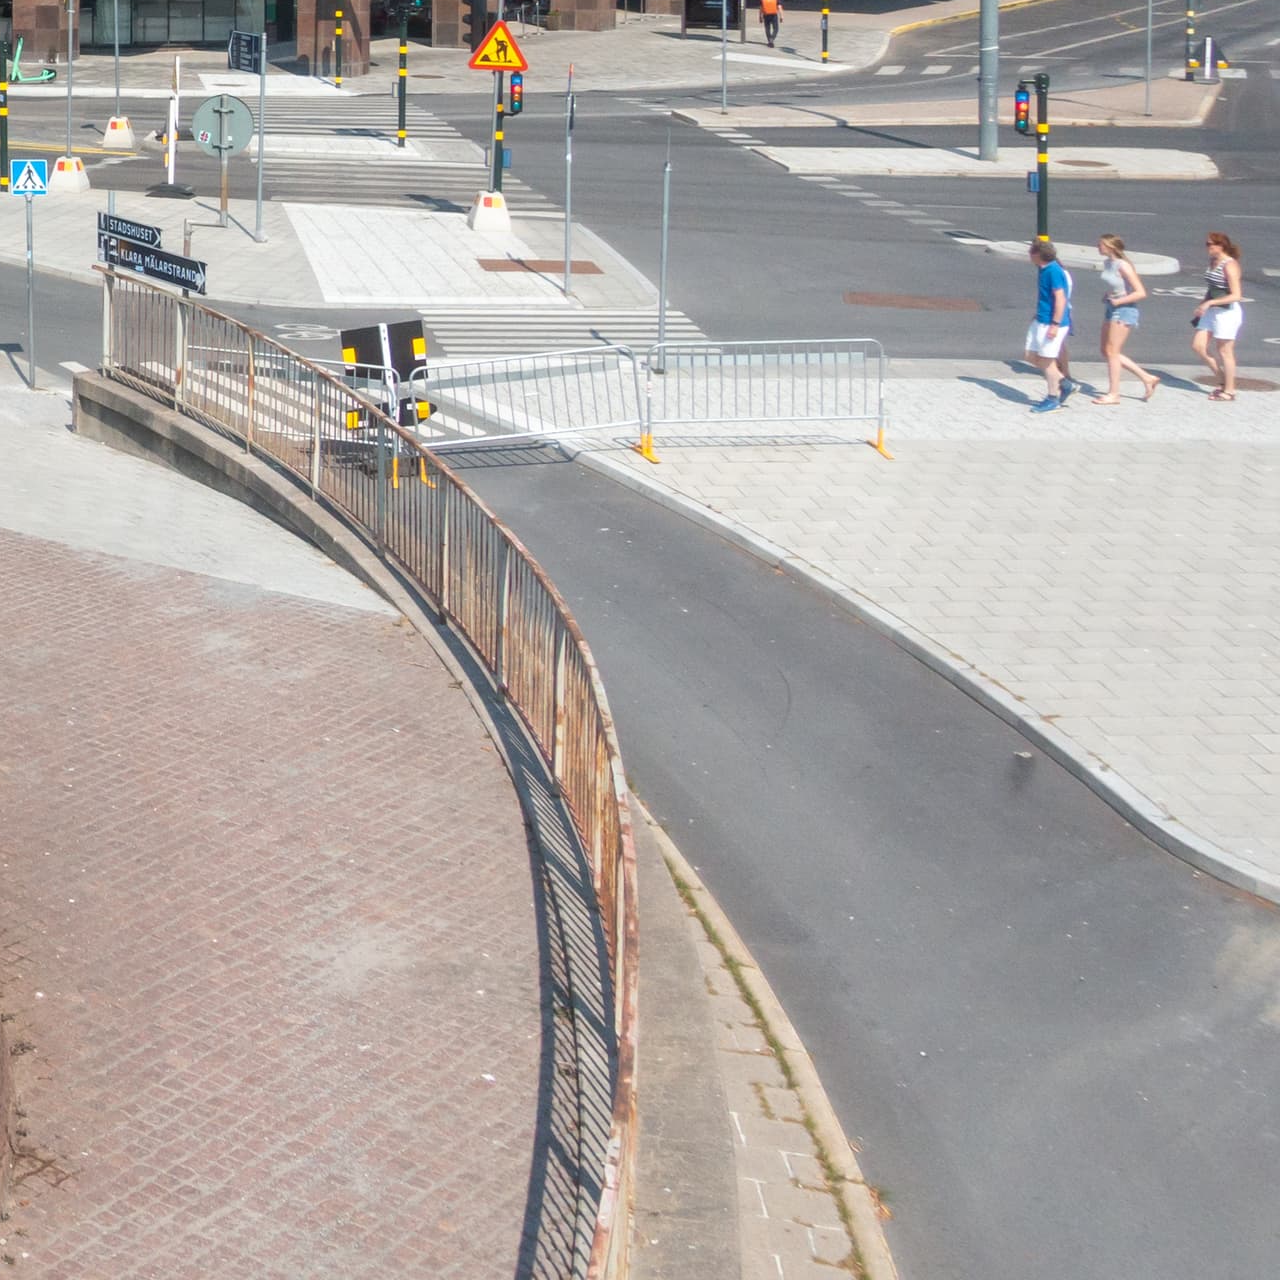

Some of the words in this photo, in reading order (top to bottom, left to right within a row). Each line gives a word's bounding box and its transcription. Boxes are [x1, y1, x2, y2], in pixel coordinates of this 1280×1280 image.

[110, 219, 153, 241] STADSHUSET
[121, 248, 142, 265] KLARA
[144, 254, 197, 283] MÄLARSTRAND
